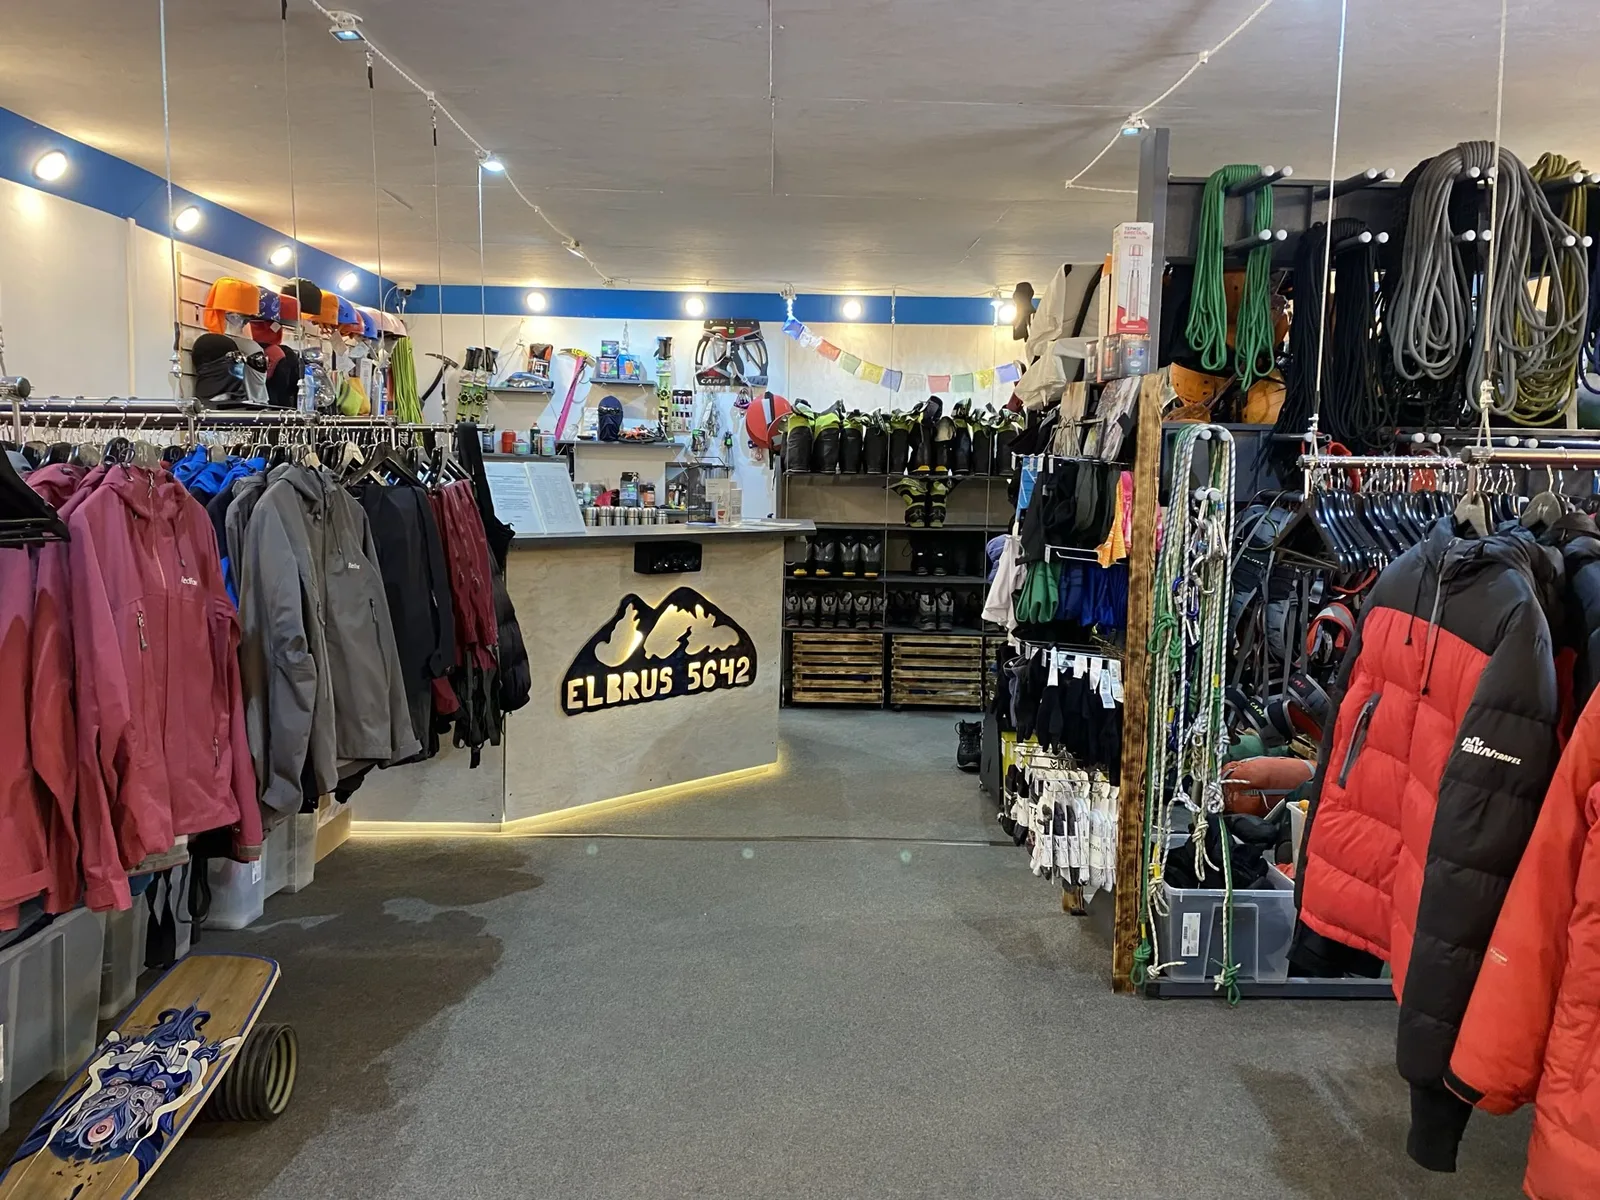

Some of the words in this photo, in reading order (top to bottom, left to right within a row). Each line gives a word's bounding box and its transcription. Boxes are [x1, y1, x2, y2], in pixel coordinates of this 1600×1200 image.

[567, 666, 673, 709] ELBRUS
[687, 656, 750, 690] 5642
[1493, 752, 1522, 765] TRAVEL
